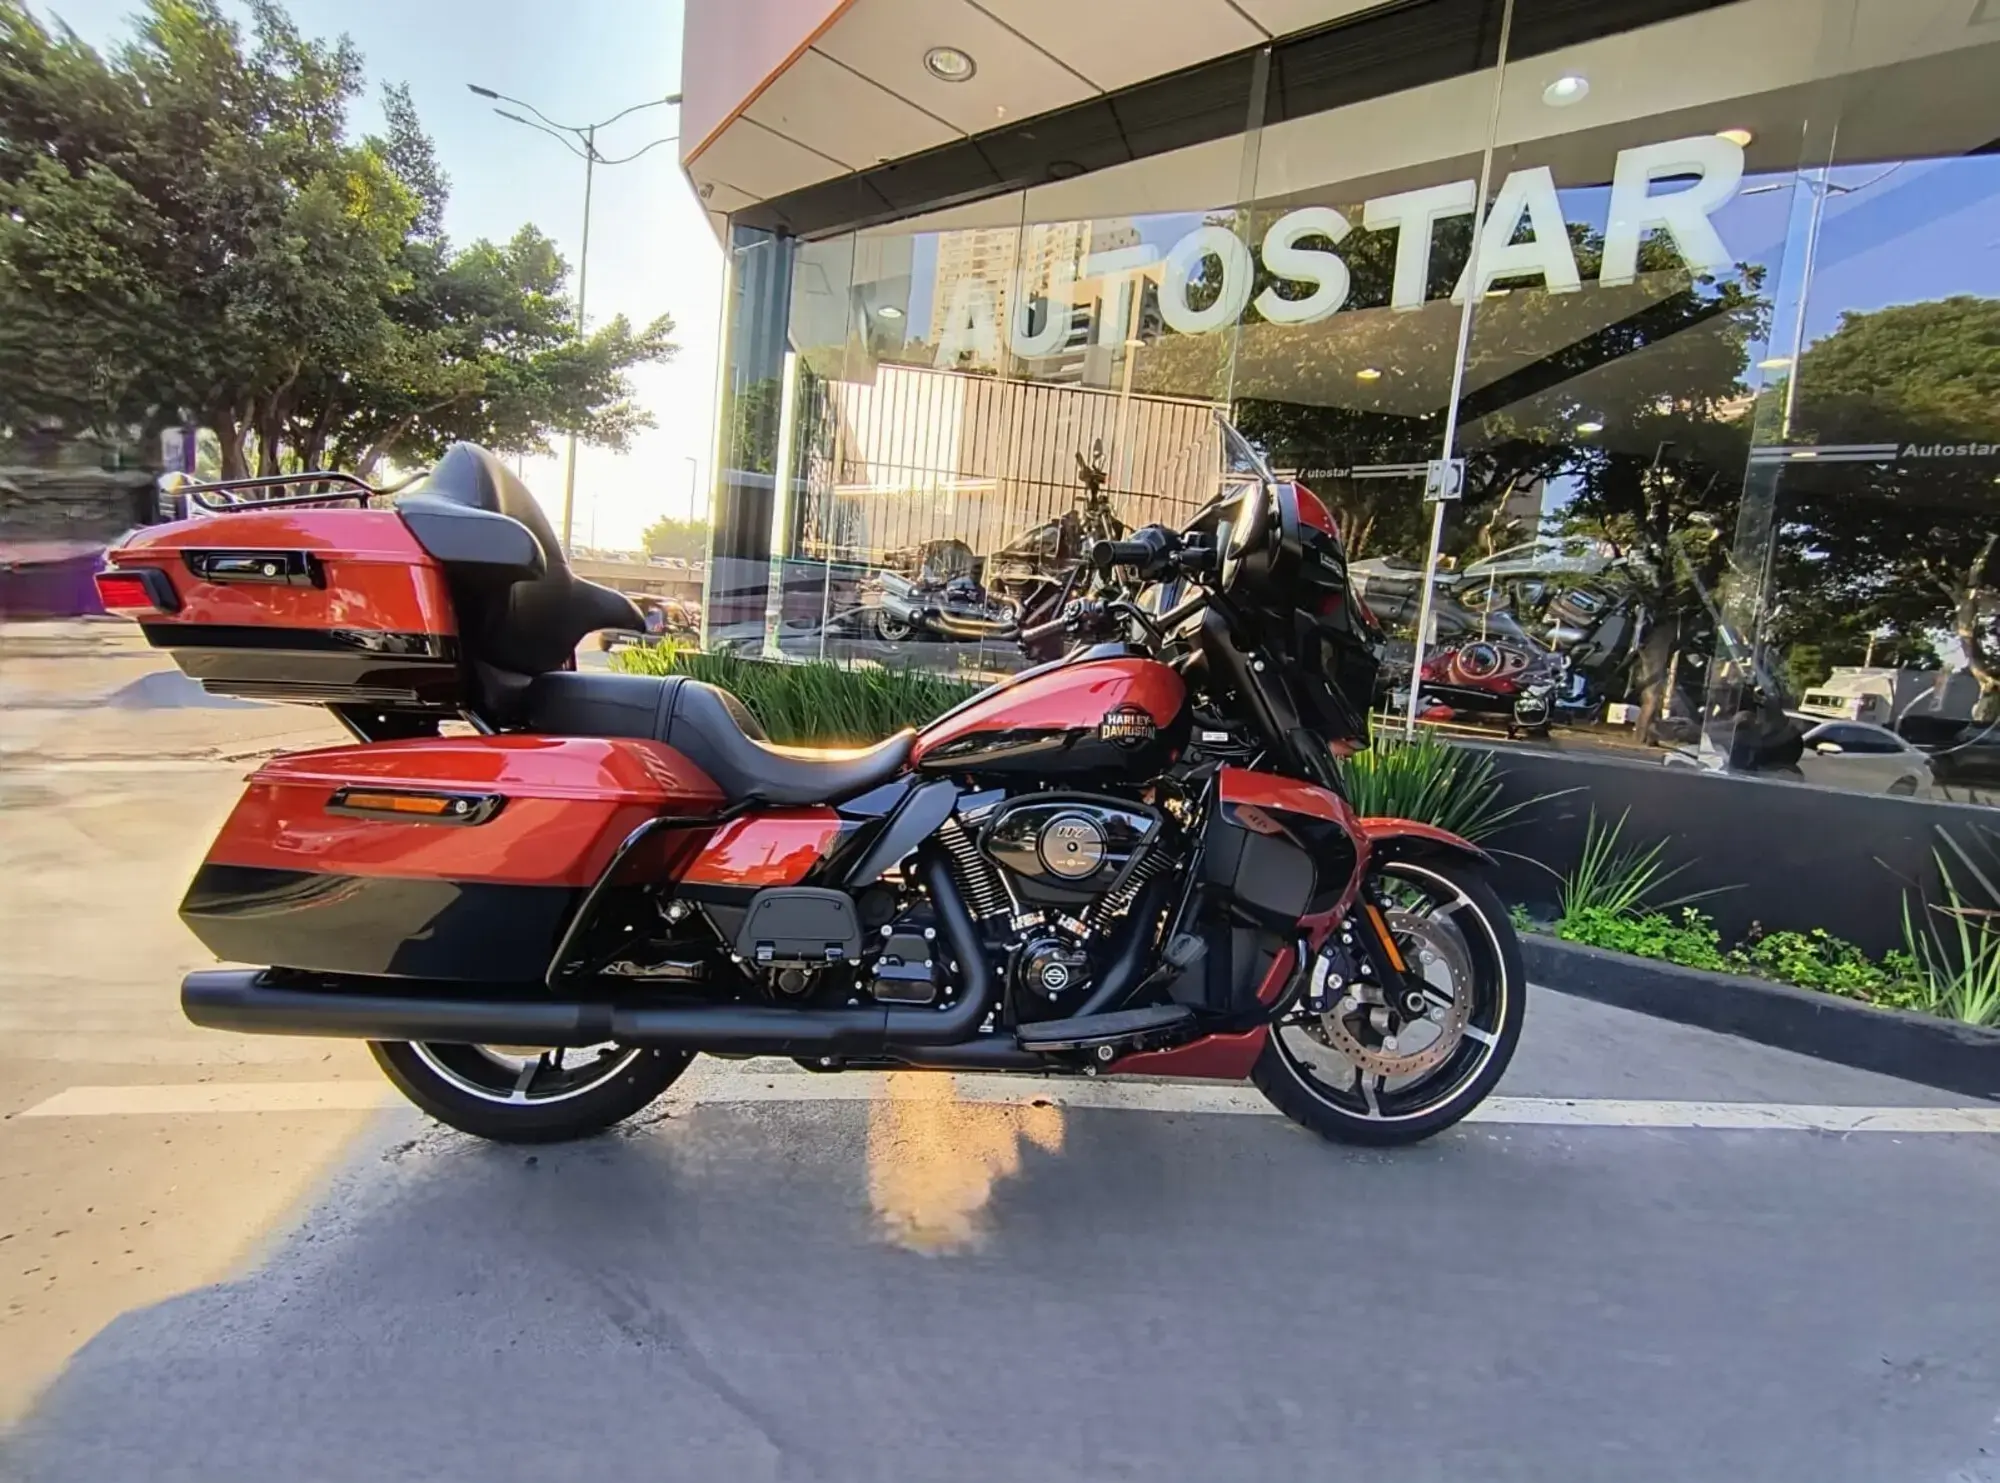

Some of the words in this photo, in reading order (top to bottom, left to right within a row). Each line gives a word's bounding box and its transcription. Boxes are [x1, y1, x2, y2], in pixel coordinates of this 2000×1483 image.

[931, 134, 1746, 372] AUTOSTAR
[1901, 442, 2000, 458] Autostar
[1102, 724, 1156, 740] DAVIDSON
